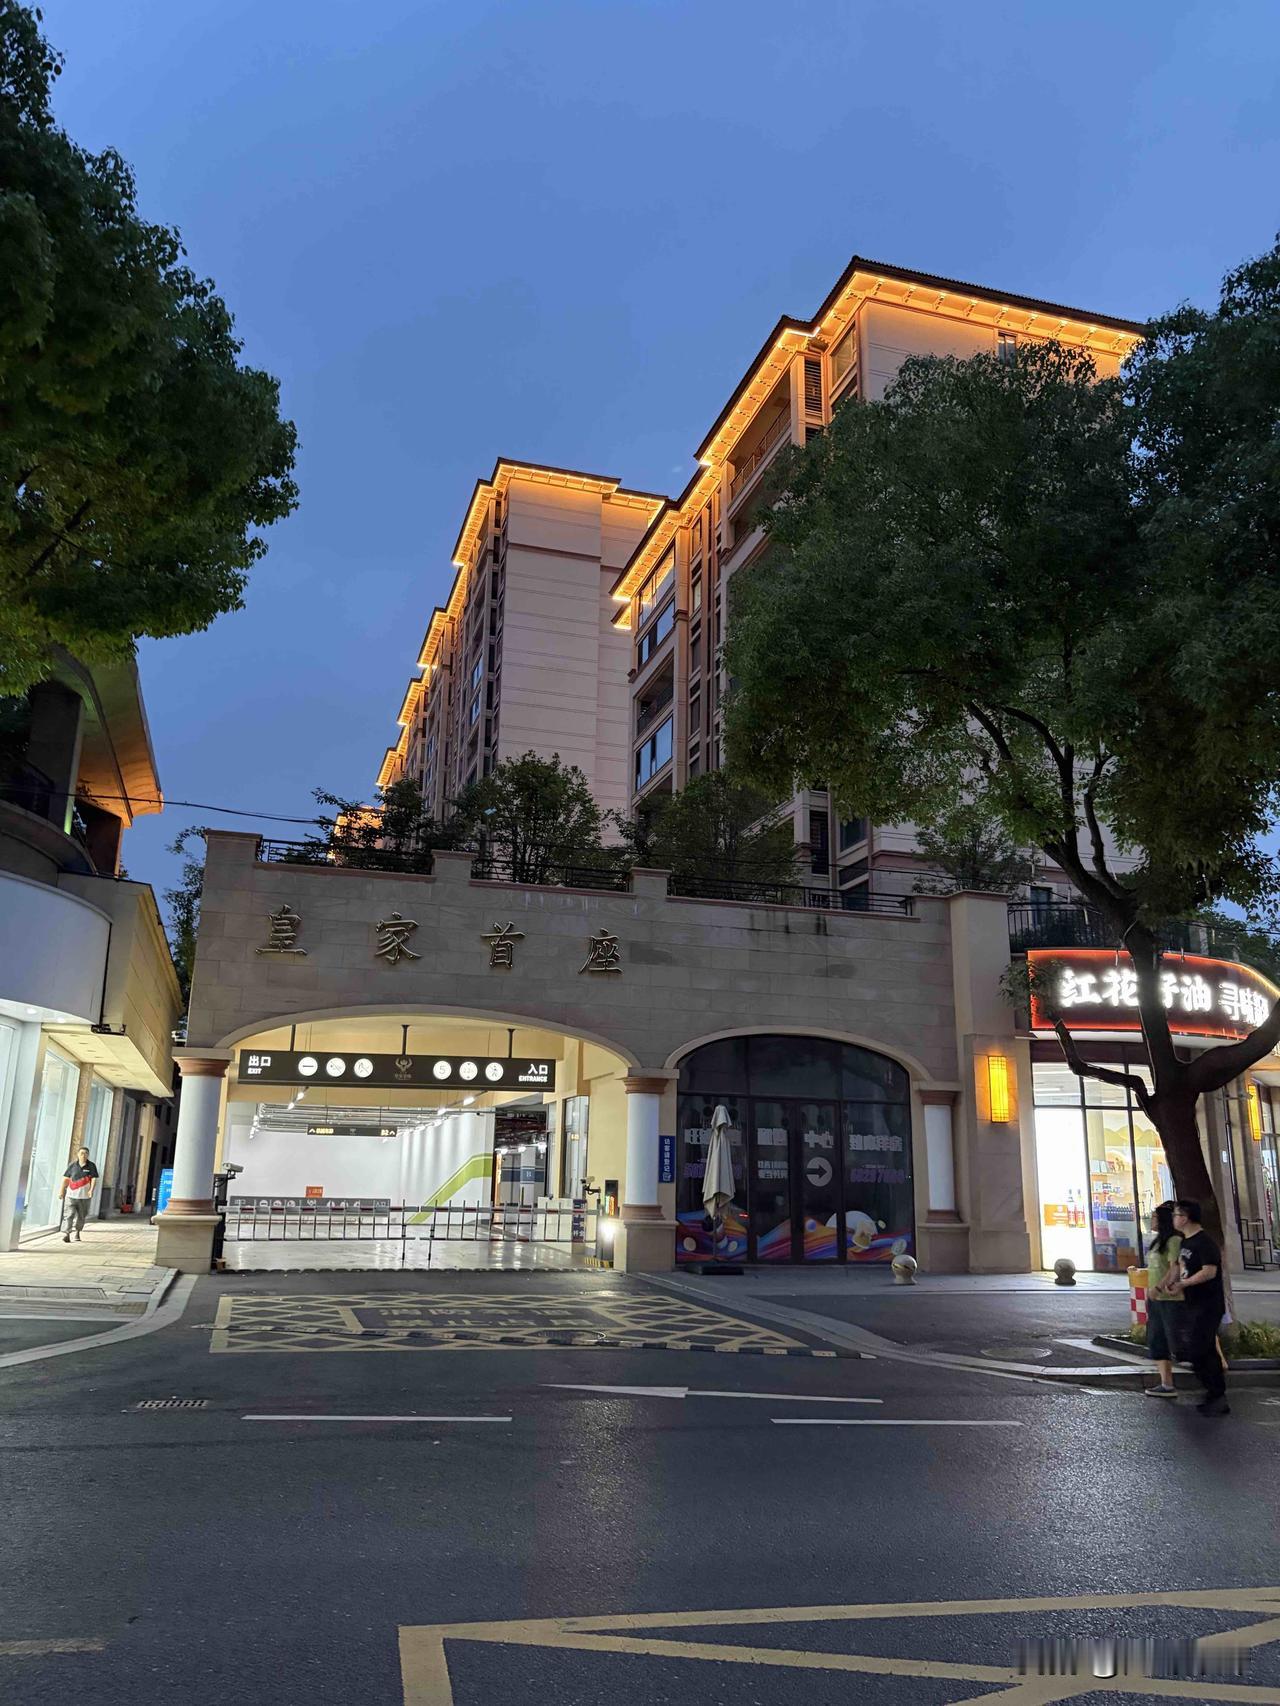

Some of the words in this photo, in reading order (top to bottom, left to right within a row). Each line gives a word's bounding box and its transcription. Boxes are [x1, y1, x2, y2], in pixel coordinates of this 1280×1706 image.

[255, 904, 624, 975] 皇家首座
[248, 1055, 271, 1067] 出口
[527, 1063, 549, 1075] 入口
